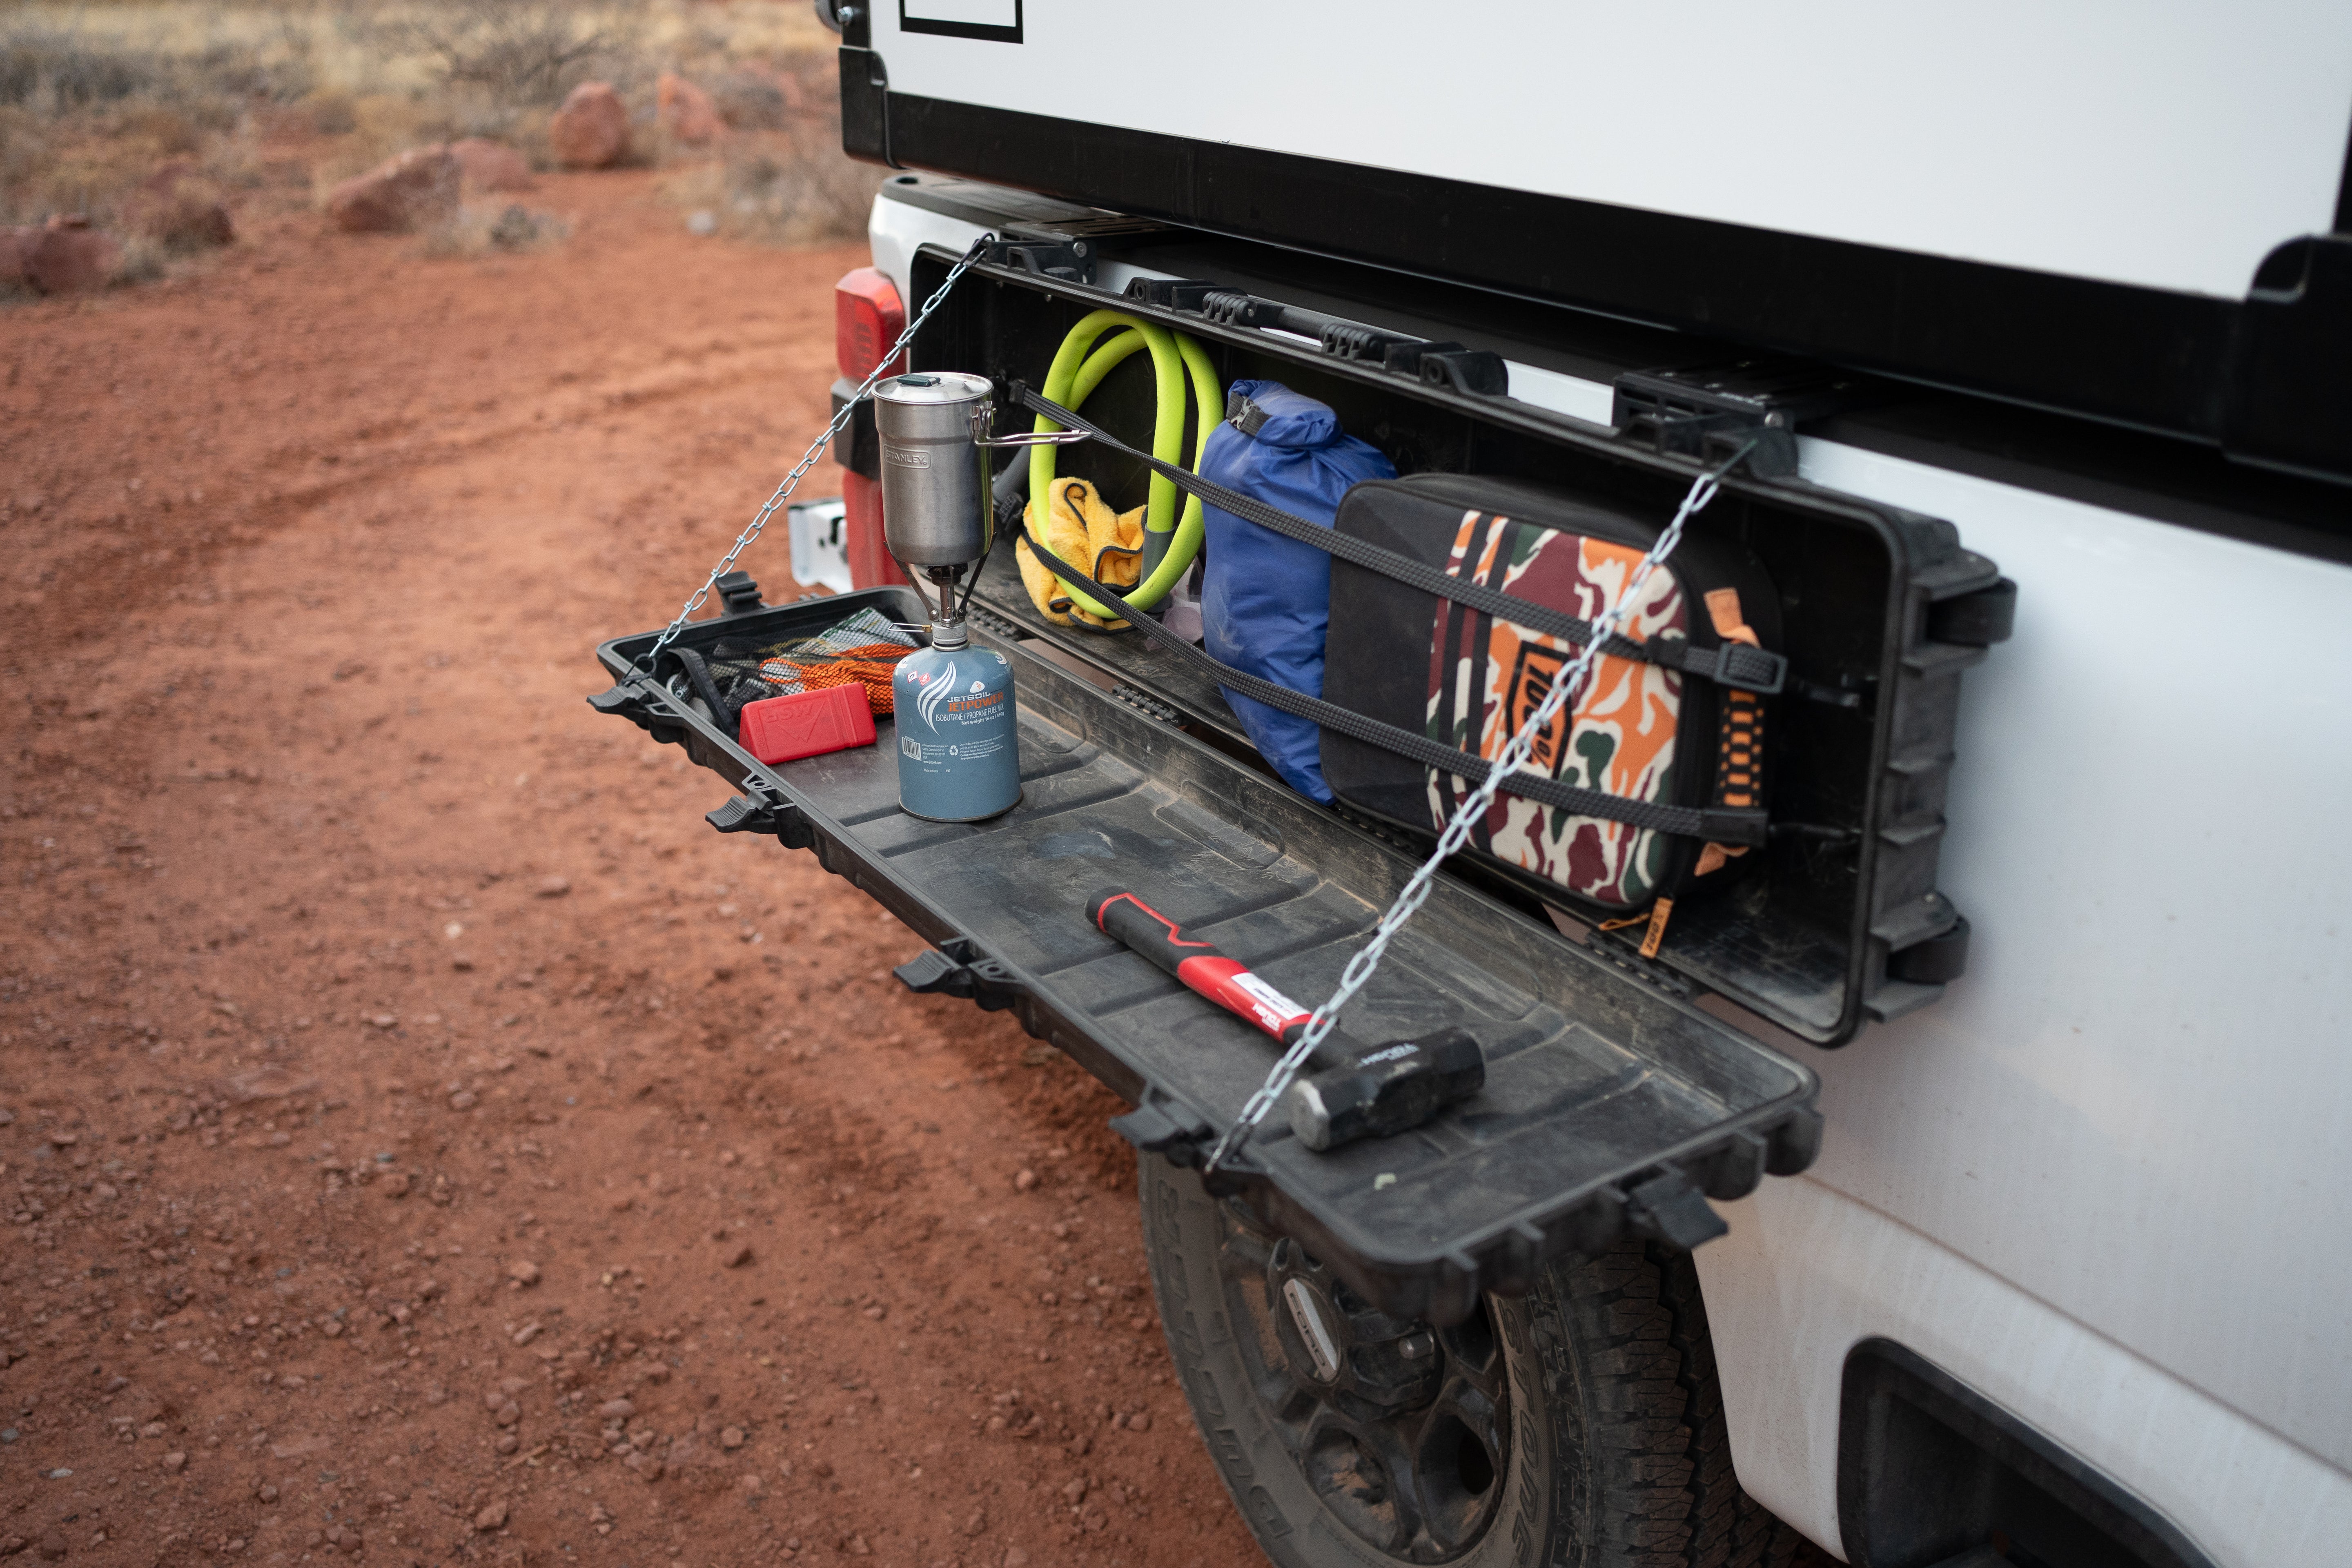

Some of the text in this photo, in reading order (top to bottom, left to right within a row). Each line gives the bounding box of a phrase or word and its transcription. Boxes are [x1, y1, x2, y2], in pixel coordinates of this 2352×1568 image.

[886, 452, 925, 464] STANLEY
[947, 691, 991, 702] JETBOIL
[948, 692, 1004, 712] JETPOWER
[765, 702, 813, 724] MSR
[936, 713, 963, 722] ISOBUTANE
[966, 709, 988, 719] PROPANE
[987, 706, 998, 716] FUEL
[1289, 1292, 1326, 1367] FORD
